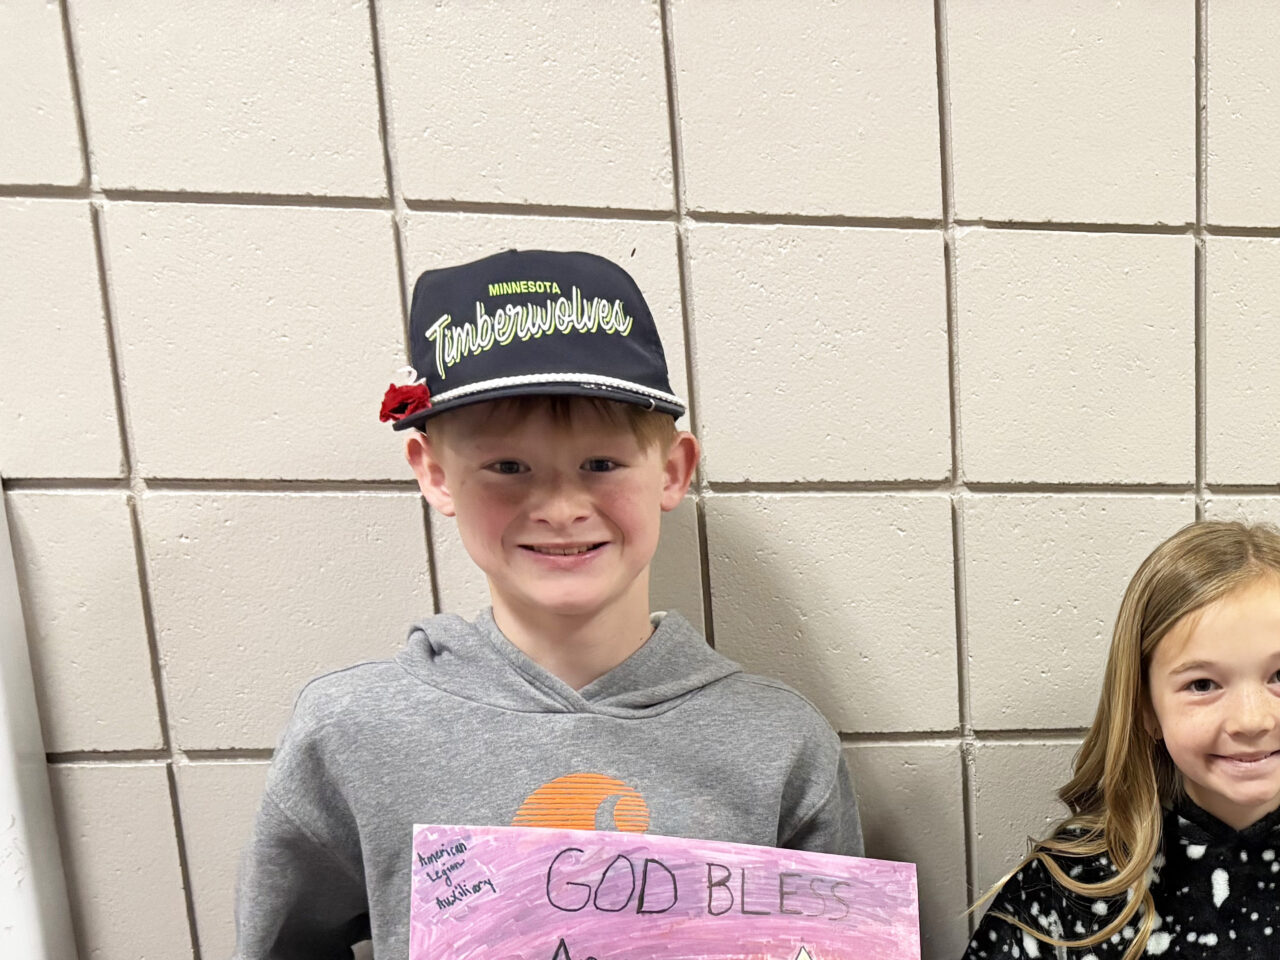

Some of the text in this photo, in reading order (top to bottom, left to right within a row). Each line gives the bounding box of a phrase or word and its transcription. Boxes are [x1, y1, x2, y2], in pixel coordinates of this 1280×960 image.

[488, 281, 560, 296] MINNESOTA
[425, 286, 633, 379] Timberwolves
[416, 842, 468, 868] American
[426, 858, 466, 888] Legion
[546, 848, 852, 921] GOD BLESS
